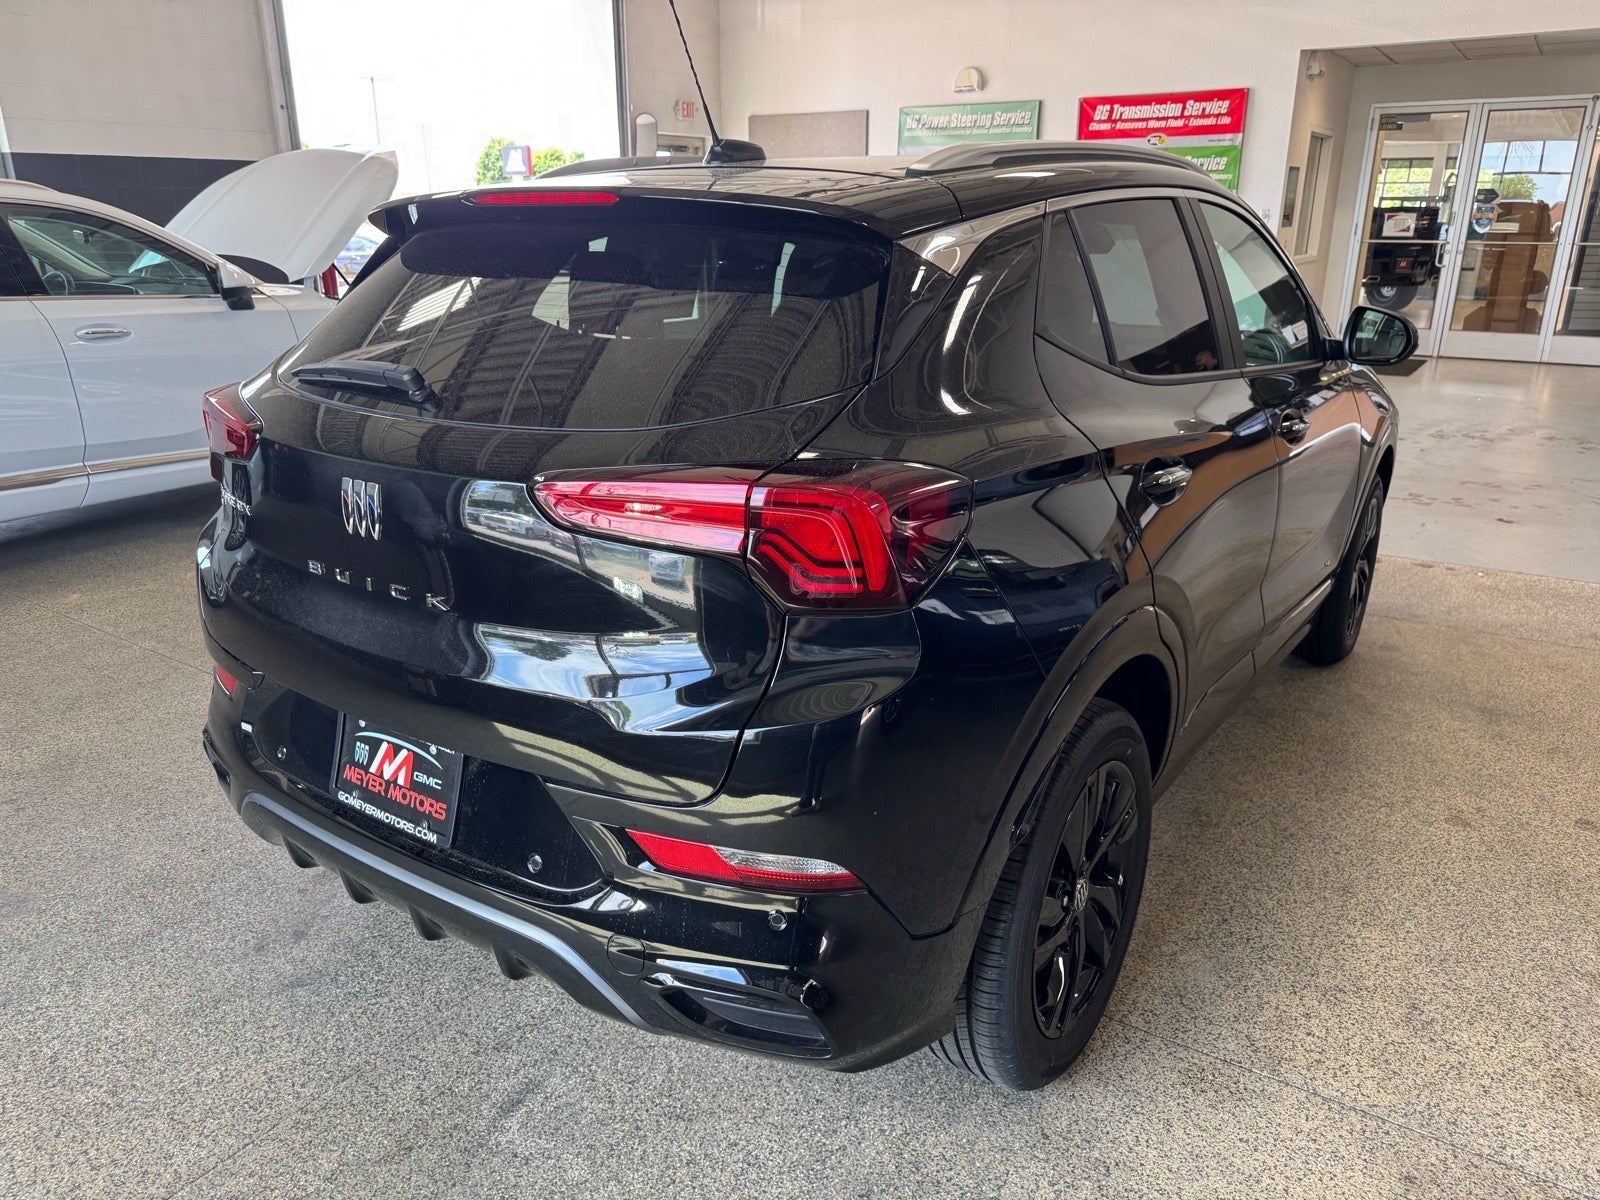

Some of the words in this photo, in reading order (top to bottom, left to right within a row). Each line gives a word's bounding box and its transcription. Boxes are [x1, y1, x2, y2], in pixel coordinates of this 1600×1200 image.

[682, 101, 695, 119] EXIT
[906, 114, 920, 129] BG
[919, 114, 950, 129] Power
[950, 112, 993, 129] Steering
[993, 109, 1032, 126] Service
[1093, 104, 1110, 121] BG
[1111, 101, 1183, 120] Transmission
[1183, 98, 1231, 116] Service
[1088, 121, 1112, 131] Cleans
[1115, 120, 1147, 130] Removes
[1147, 119, 1166, 129] Worn
[1165, 118, 1184, 128] Fluid
[1188, 117, 1217, 127] Extends
[1216, 115, 1232, 125] Life
[307, 559, 451, 611] BUICK
[413, 771, 442, 790] GMC
[343, 764, 386, 796] MEYER
[387, 783, 447, 821] MOTORS
[338, 791, 437, 844] GOMEYERMOTORS.COM
